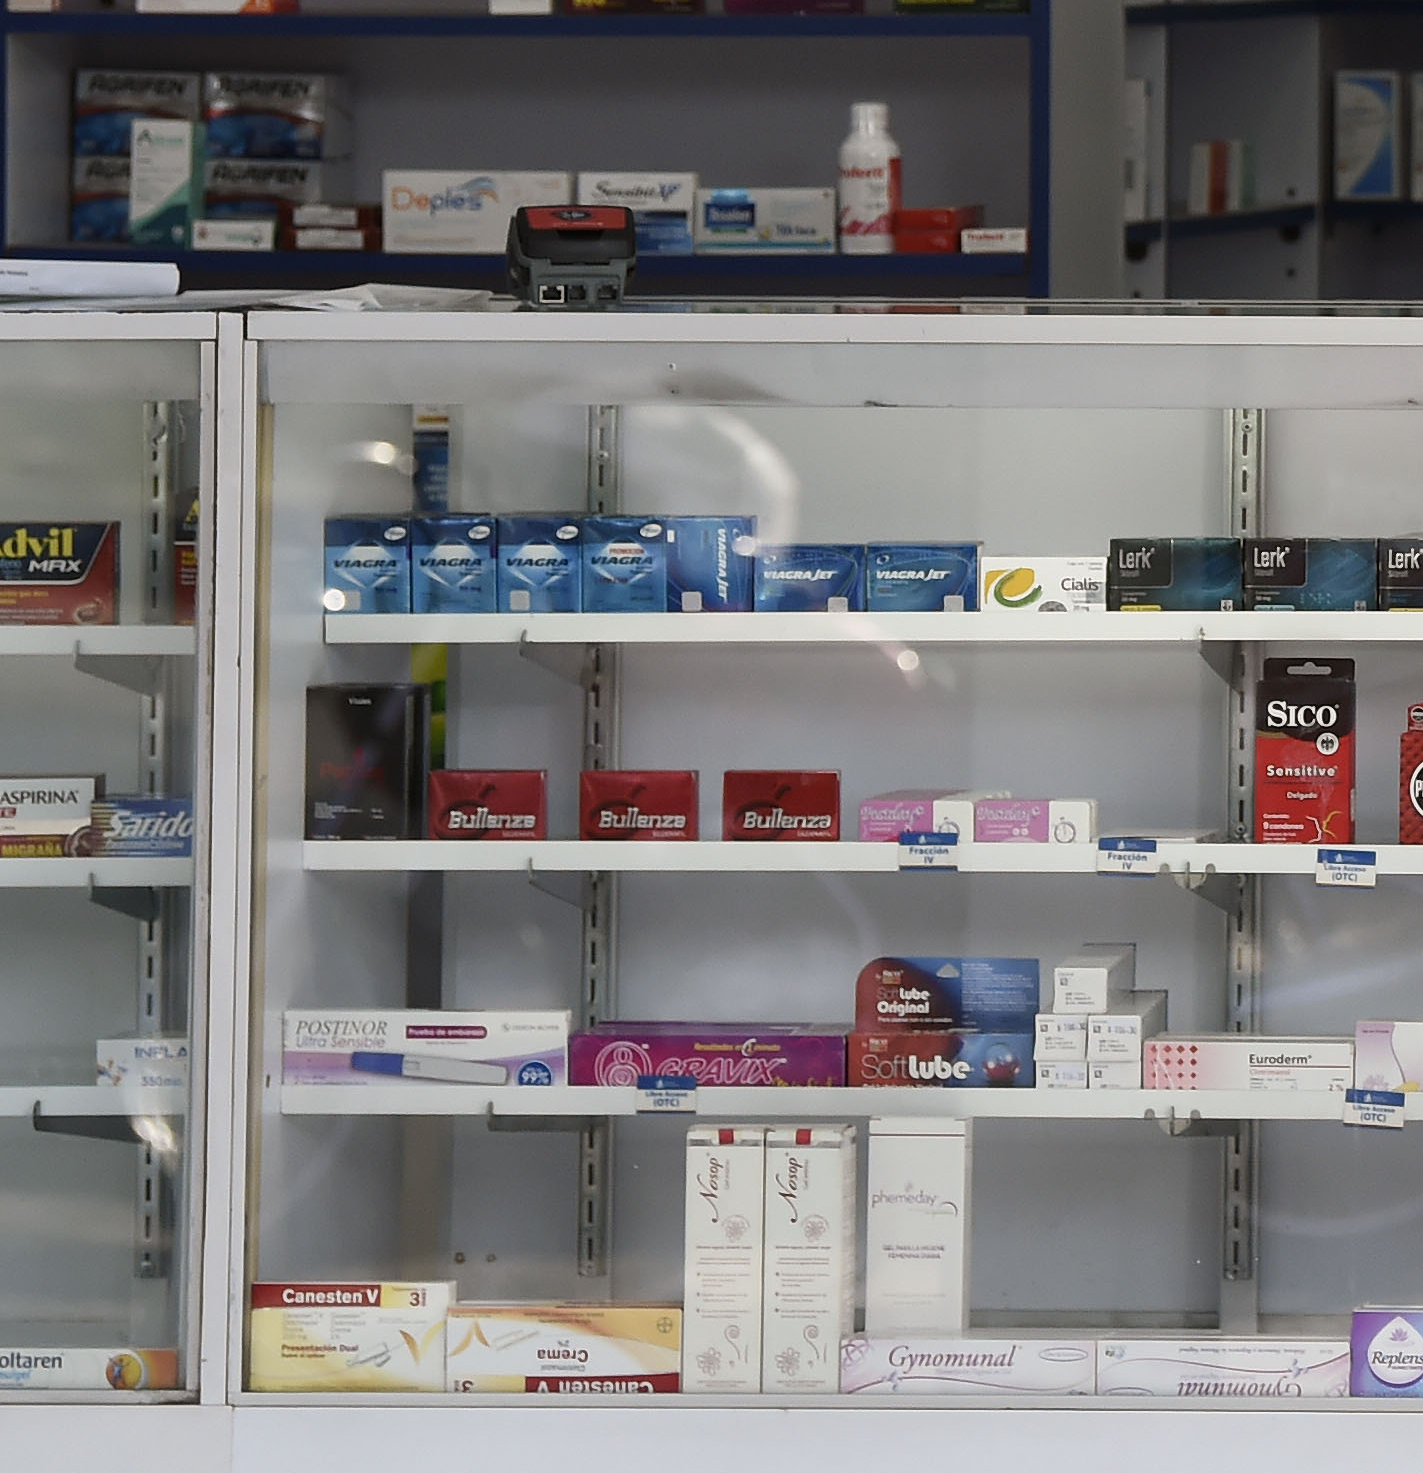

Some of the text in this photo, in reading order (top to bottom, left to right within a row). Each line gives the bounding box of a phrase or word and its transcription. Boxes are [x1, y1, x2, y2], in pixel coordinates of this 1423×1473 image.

[28, 559, 83, 573] MAX
[333, 557, 398, 569] VIAGRA
[1118, 548, 1151, 570] Lerk
[1061, 578, 1099, 593] Cialis
[1266, 700, 1338, 728] SICO
[1266, 764, 1334, 779] Sensitive
[1, 789, 77, 804] ASPIRINA
[448, 808, 537, 830] Bullenza
[295, 1019, 388, 1036] POSTINOR
[295, 1036, 386, 1049] Ultra Sensible
[1249, 1053, 1307, 1065] Euroderm
[658, 1057, 778, 1085] GRAVIX
[871, 1191, 937, 1209] phemeday
[281, 1288, 379, 1304] Canesten V
[888, 1345, 1016, 1372] Gynomunal
